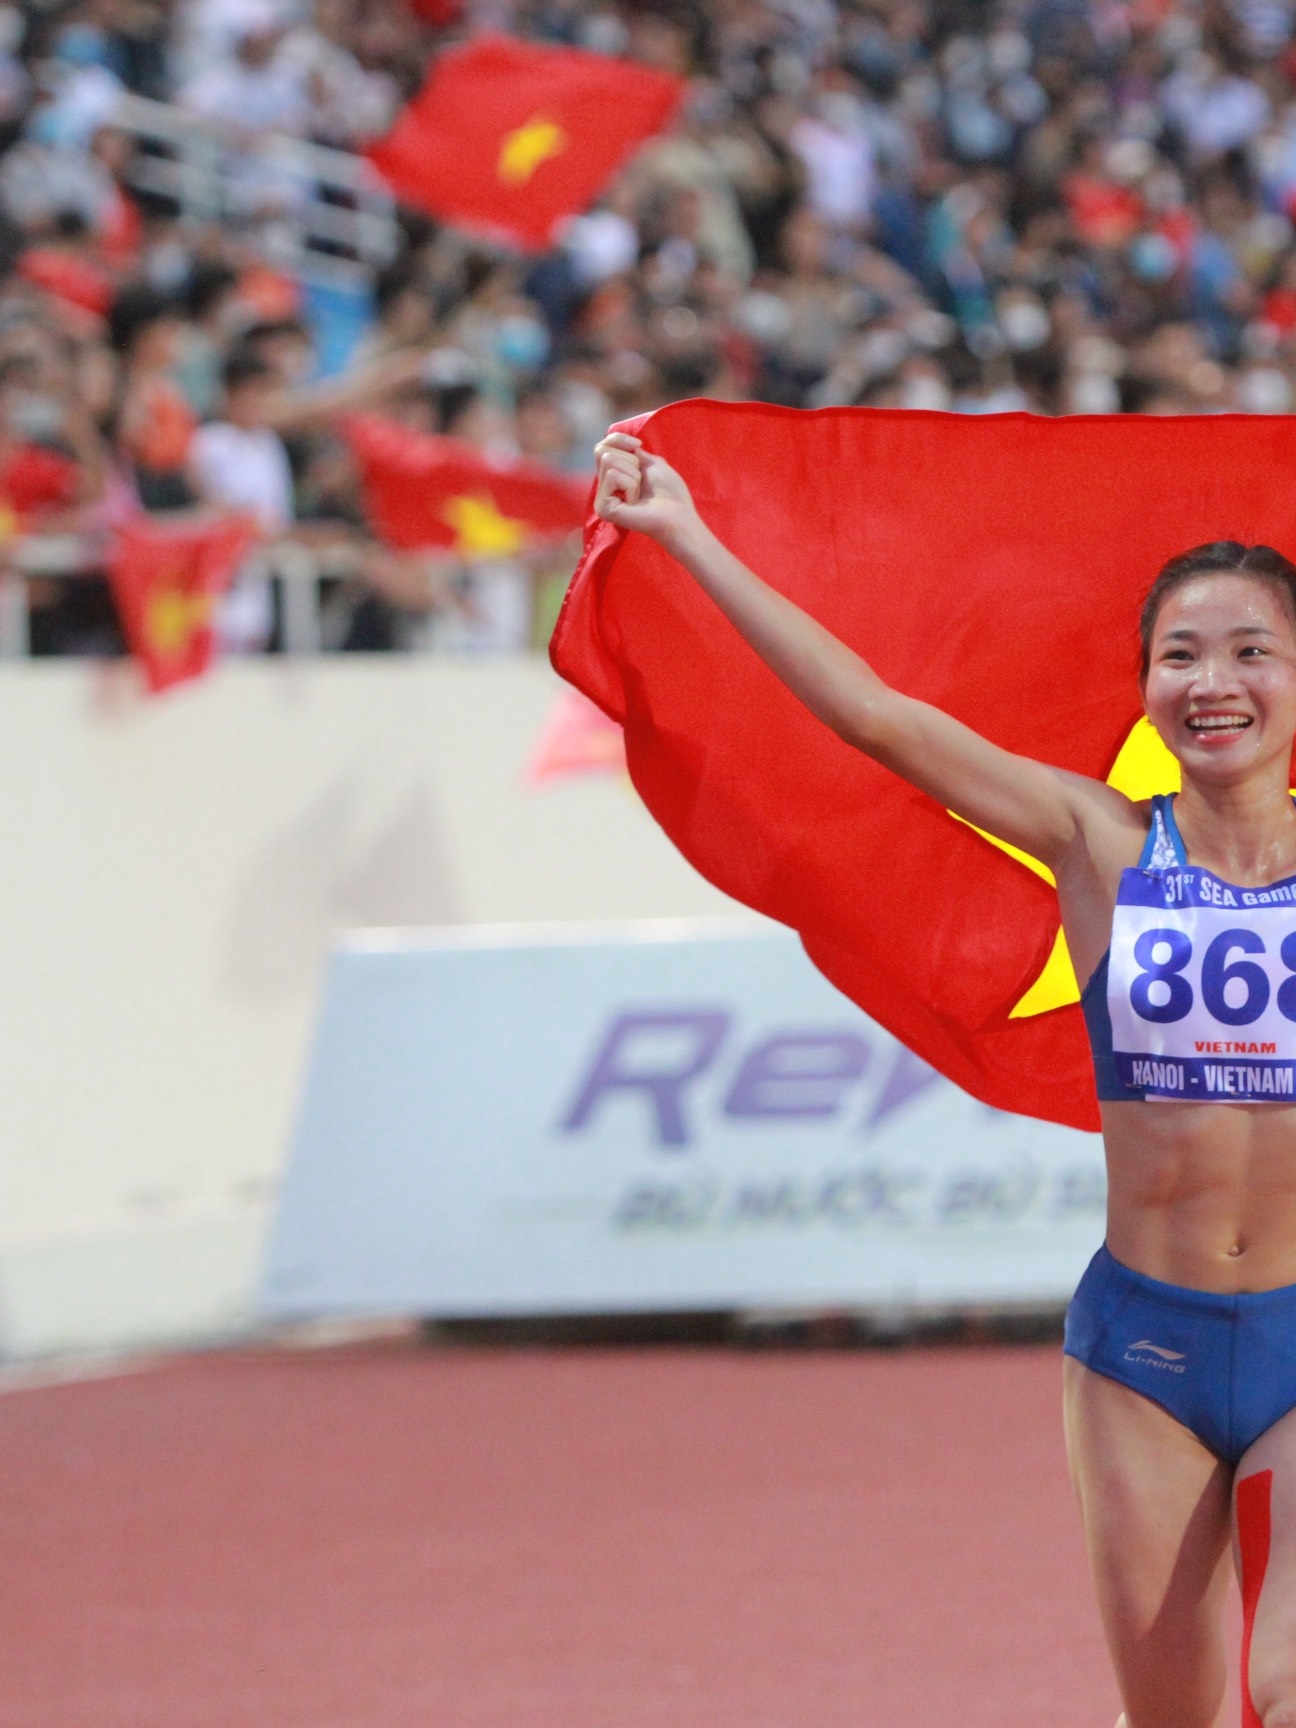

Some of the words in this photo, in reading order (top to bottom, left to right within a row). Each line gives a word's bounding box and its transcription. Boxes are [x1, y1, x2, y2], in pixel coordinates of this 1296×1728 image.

[1165, 874, 1195, 903] 31ST
[1200, 876, 1238, 907] SEA
[1194, 1041, 1277, 1054] VIETNAM
[1132, 1060, 1184, 1090] HANOI
[1204, 1064, 1293, 1094] VIETNAM
[1123, 1352, 1186, 1374] LI-NING
